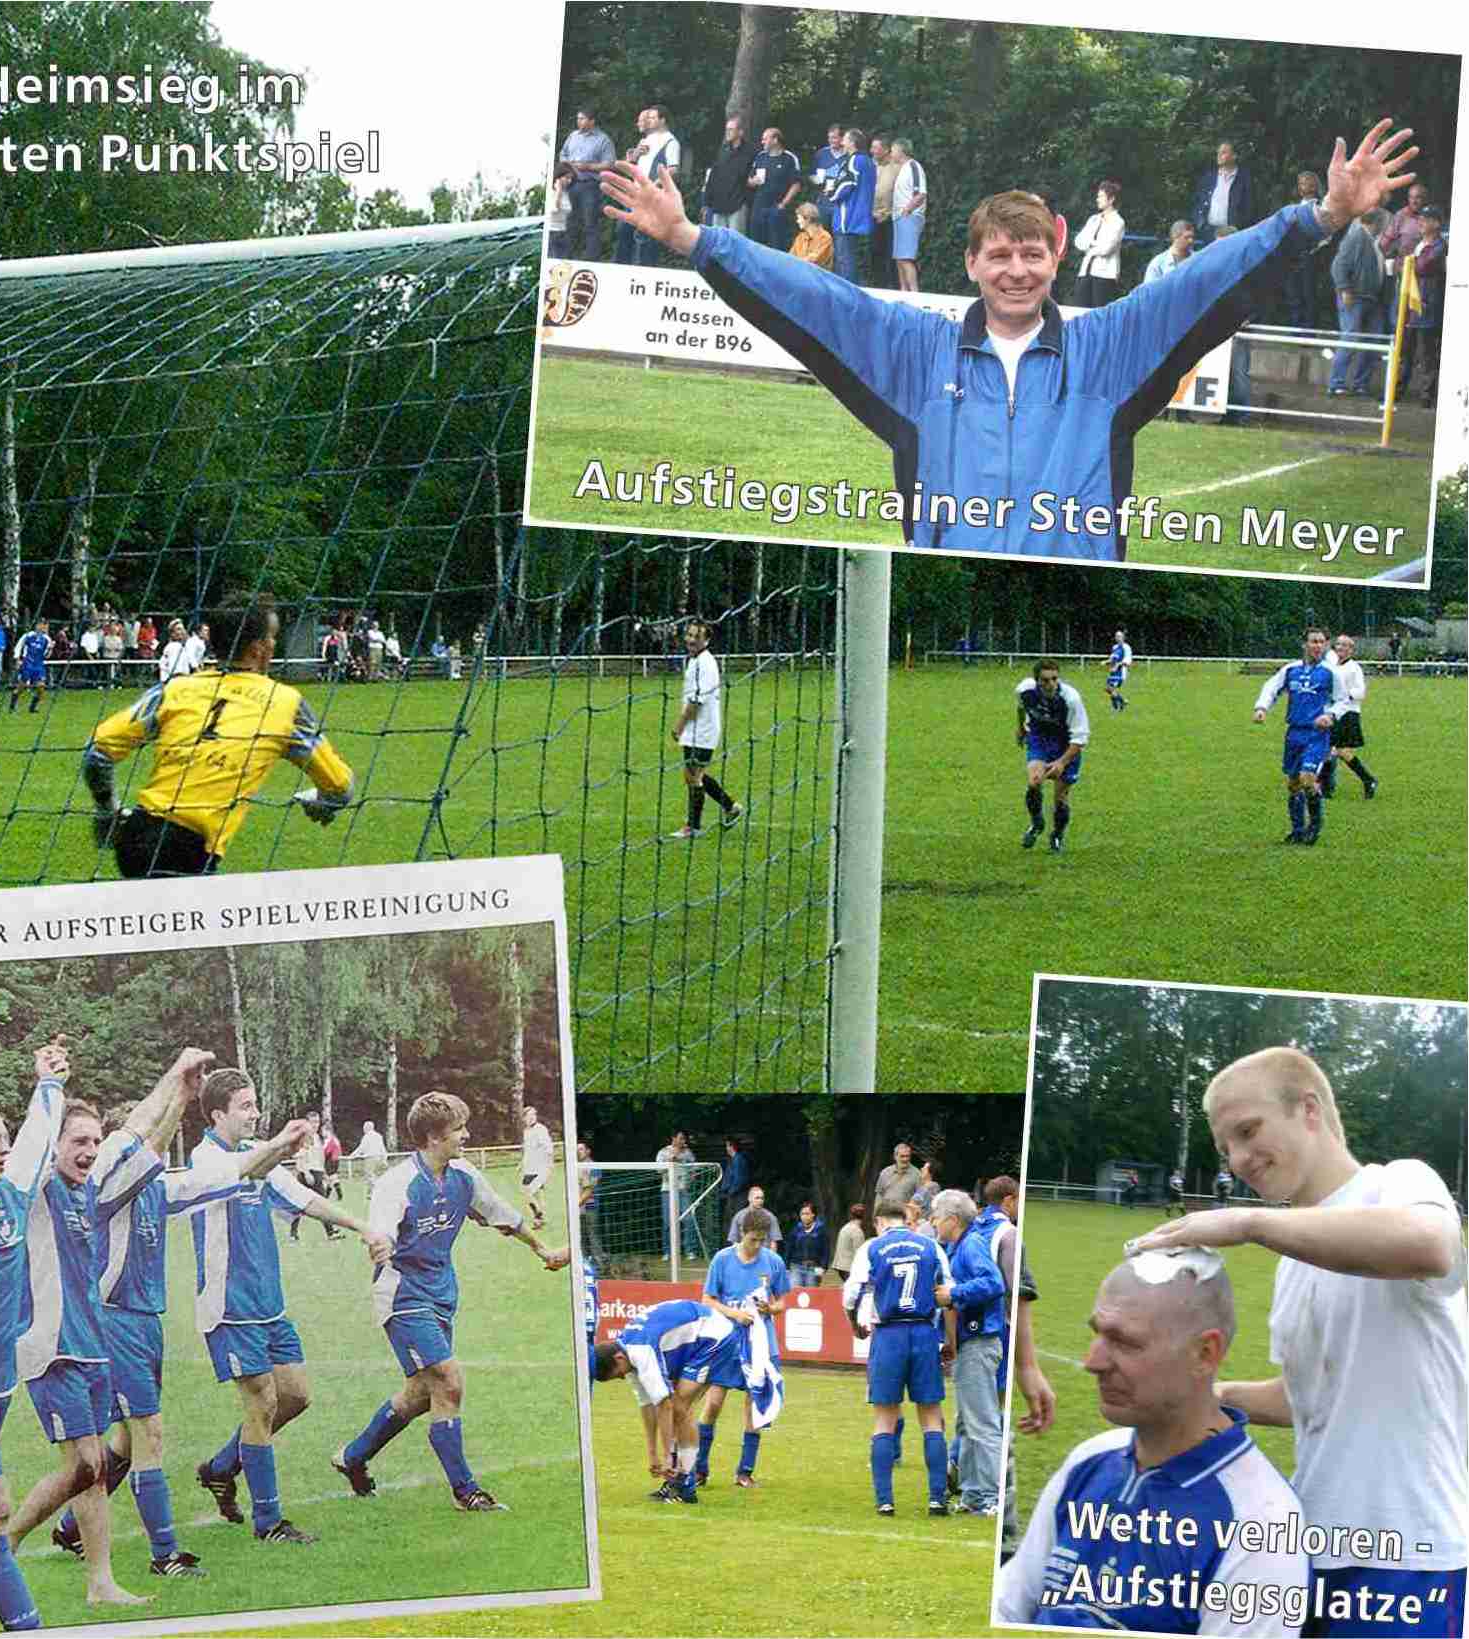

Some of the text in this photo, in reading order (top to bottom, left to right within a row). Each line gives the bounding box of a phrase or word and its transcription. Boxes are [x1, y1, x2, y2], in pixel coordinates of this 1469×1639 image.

[630, 279, 646, 296] in
[660, 305, 734, 327] Massen
[645, 330, 752, 353] an der B96
[201, 698, 228, 739] 1
[24, 910, 206, 943] AUFSTEIGER
[221, 888, 512, 929] SPIELVEREINIGUNG
[893, 1262, 917, 1311] 7
